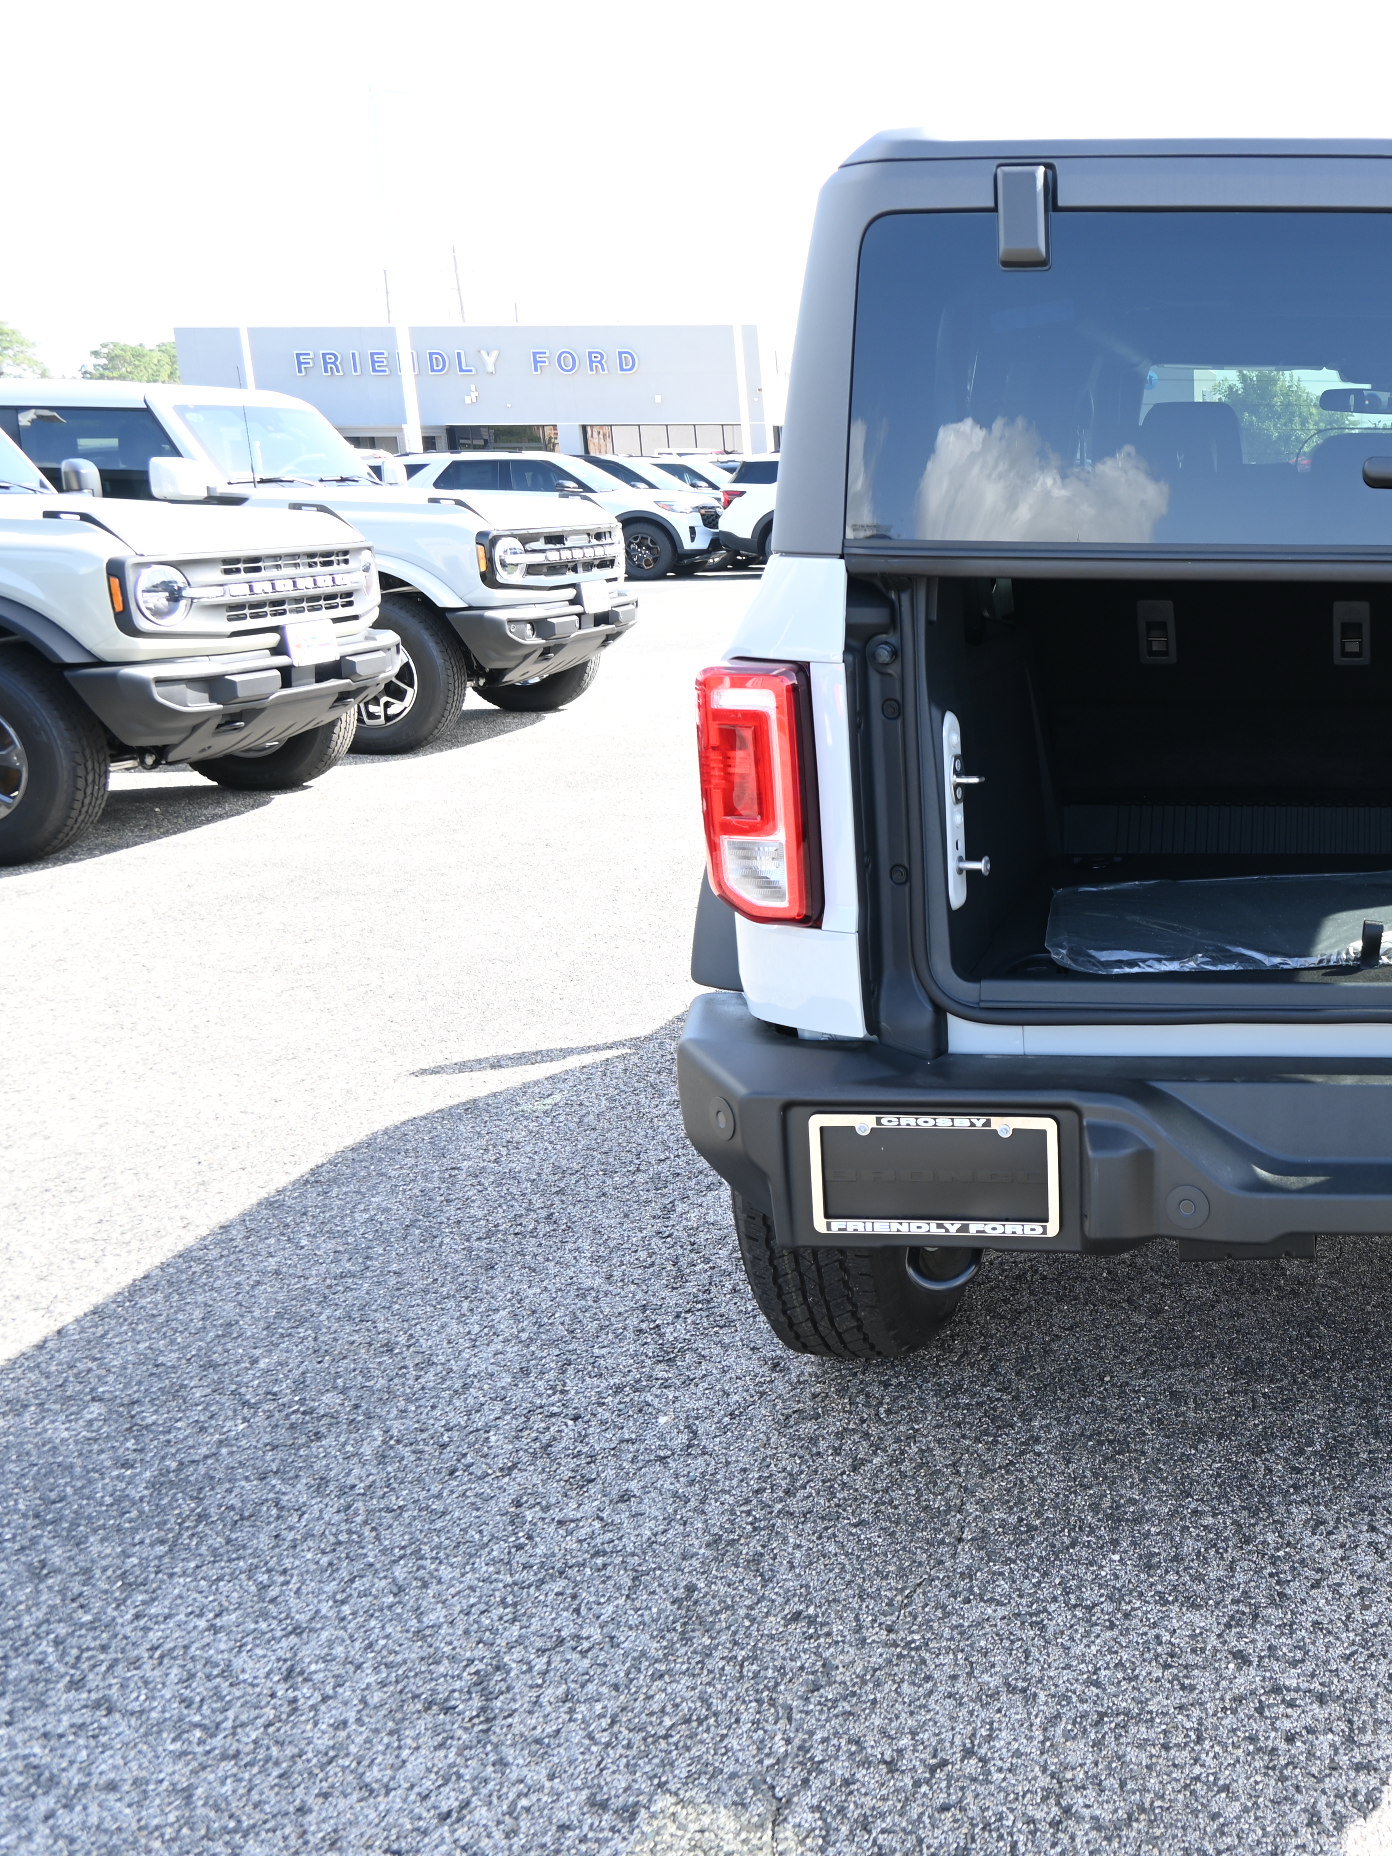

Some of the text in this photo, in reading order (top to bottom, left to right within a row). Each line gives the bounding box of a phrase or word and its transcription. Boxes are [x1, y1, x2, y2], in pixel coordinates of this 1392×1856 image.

[531, 349, 639, 375] FORD
[880, 1116, 987, 1128] CROSBY
[826, 1168, 1048, 1184] BRONCO
[830, 1220, 1044, 1236] FRIENDLY FORD
